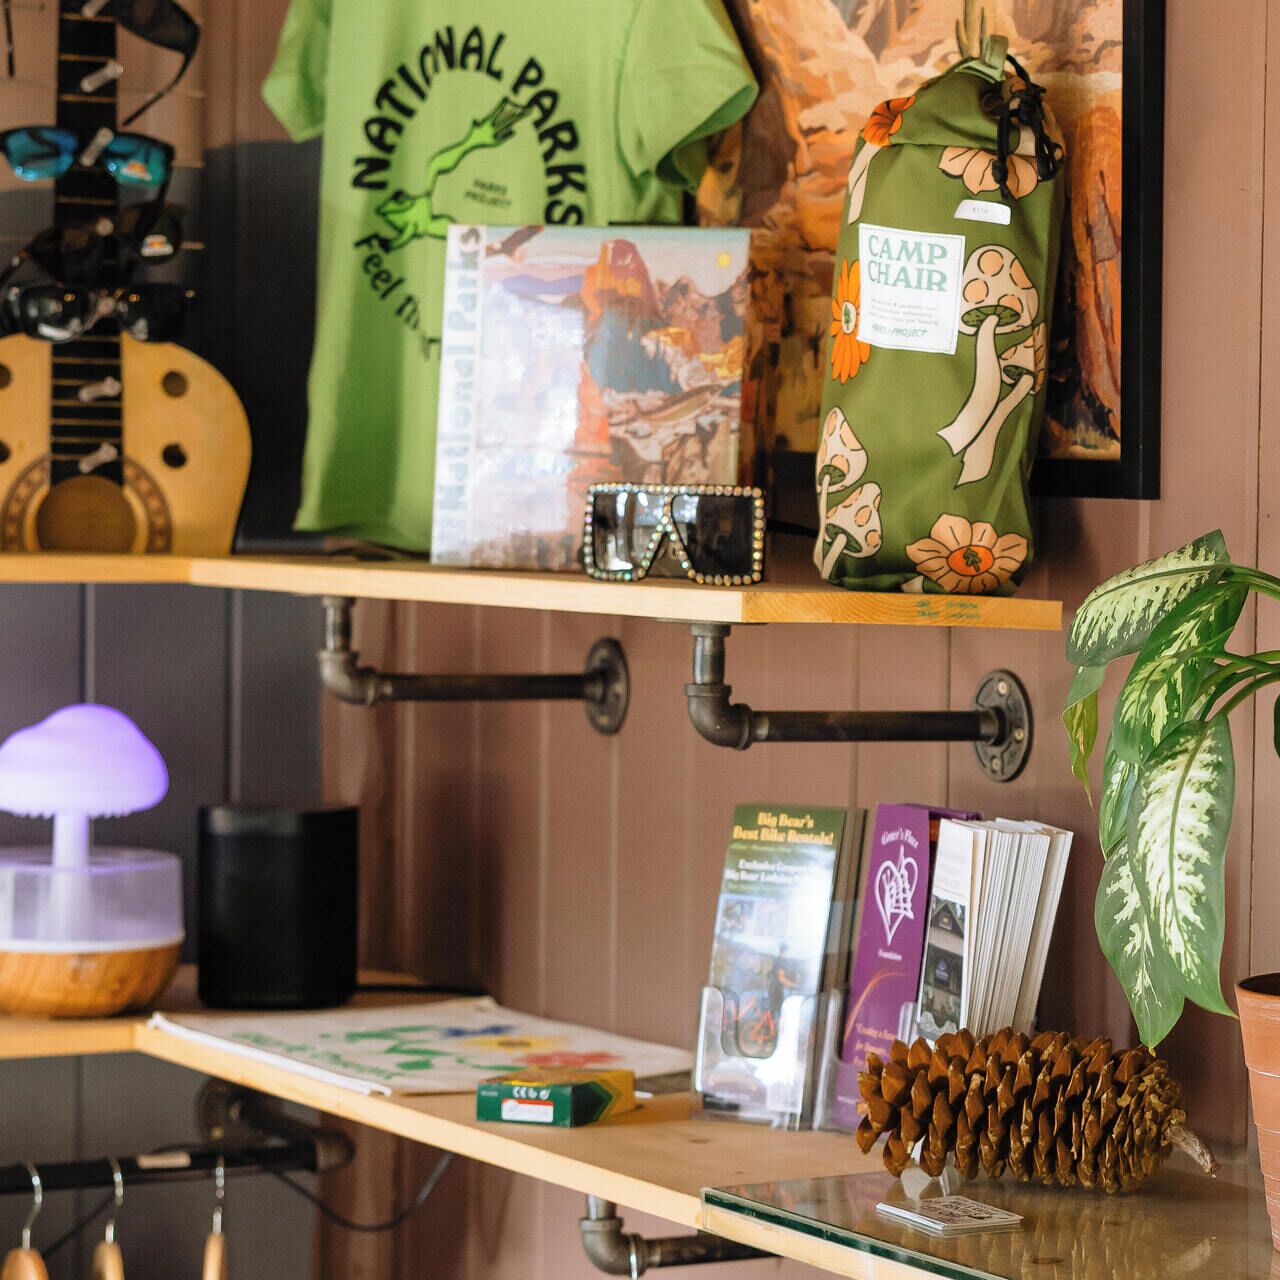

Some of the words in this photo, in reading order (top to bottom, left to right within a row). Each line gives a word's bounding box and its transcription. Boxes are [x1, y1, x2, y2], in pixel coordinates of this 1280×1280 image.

[352, 25, 506, 190] NATIONAL
[512, 56, 587, 224] PARKS
[868, 235, 948, 265] CAMP
[448, 227, 481, 331] Parks
[867, 260, 948, 293] CHAIR
[757, 812, 778, 828] Big
